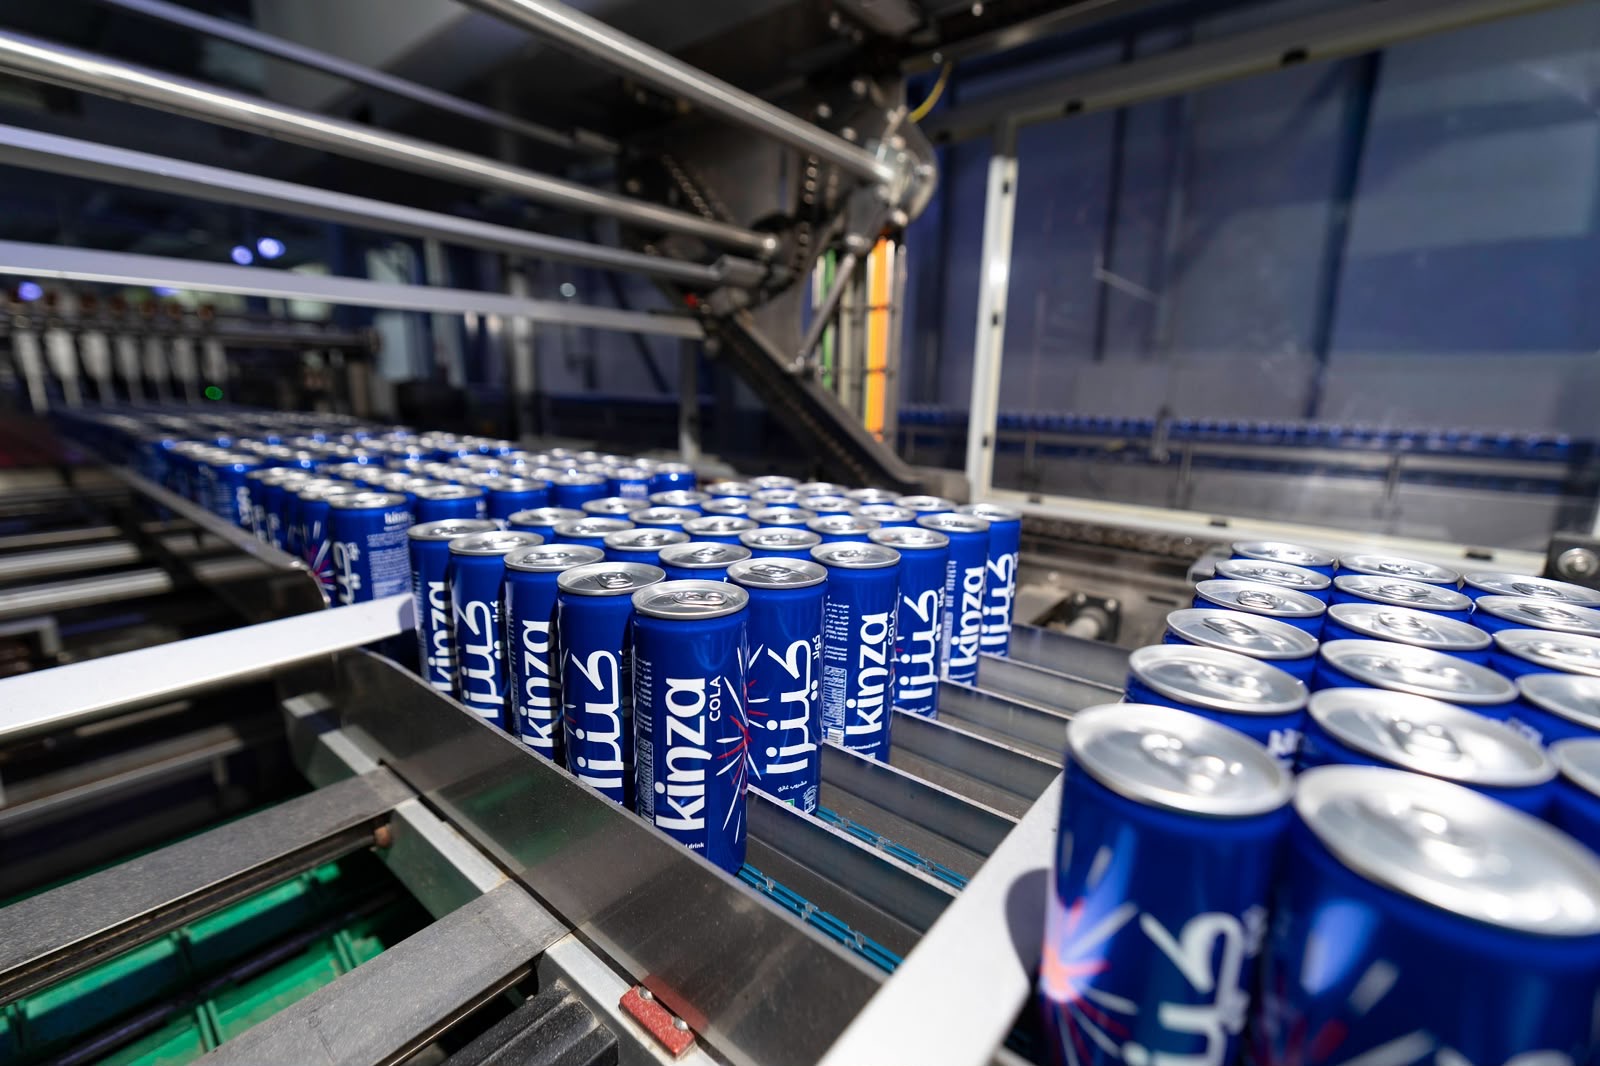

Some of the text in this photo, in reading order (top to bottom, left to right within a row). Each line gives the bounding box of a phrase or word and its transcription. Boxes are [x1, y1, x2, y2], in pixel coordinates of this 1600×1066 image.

[427, 581, 456, 692] kinza
[846, 612, 889, 735] kinza
[950, 566, 985, 667] kinza
[520, 620, 561, 748] kinza
[709, 675, 722, 722] COLA
[766, 639, 818, 774] كينزا
[654, 678, 712, 831] kinza
